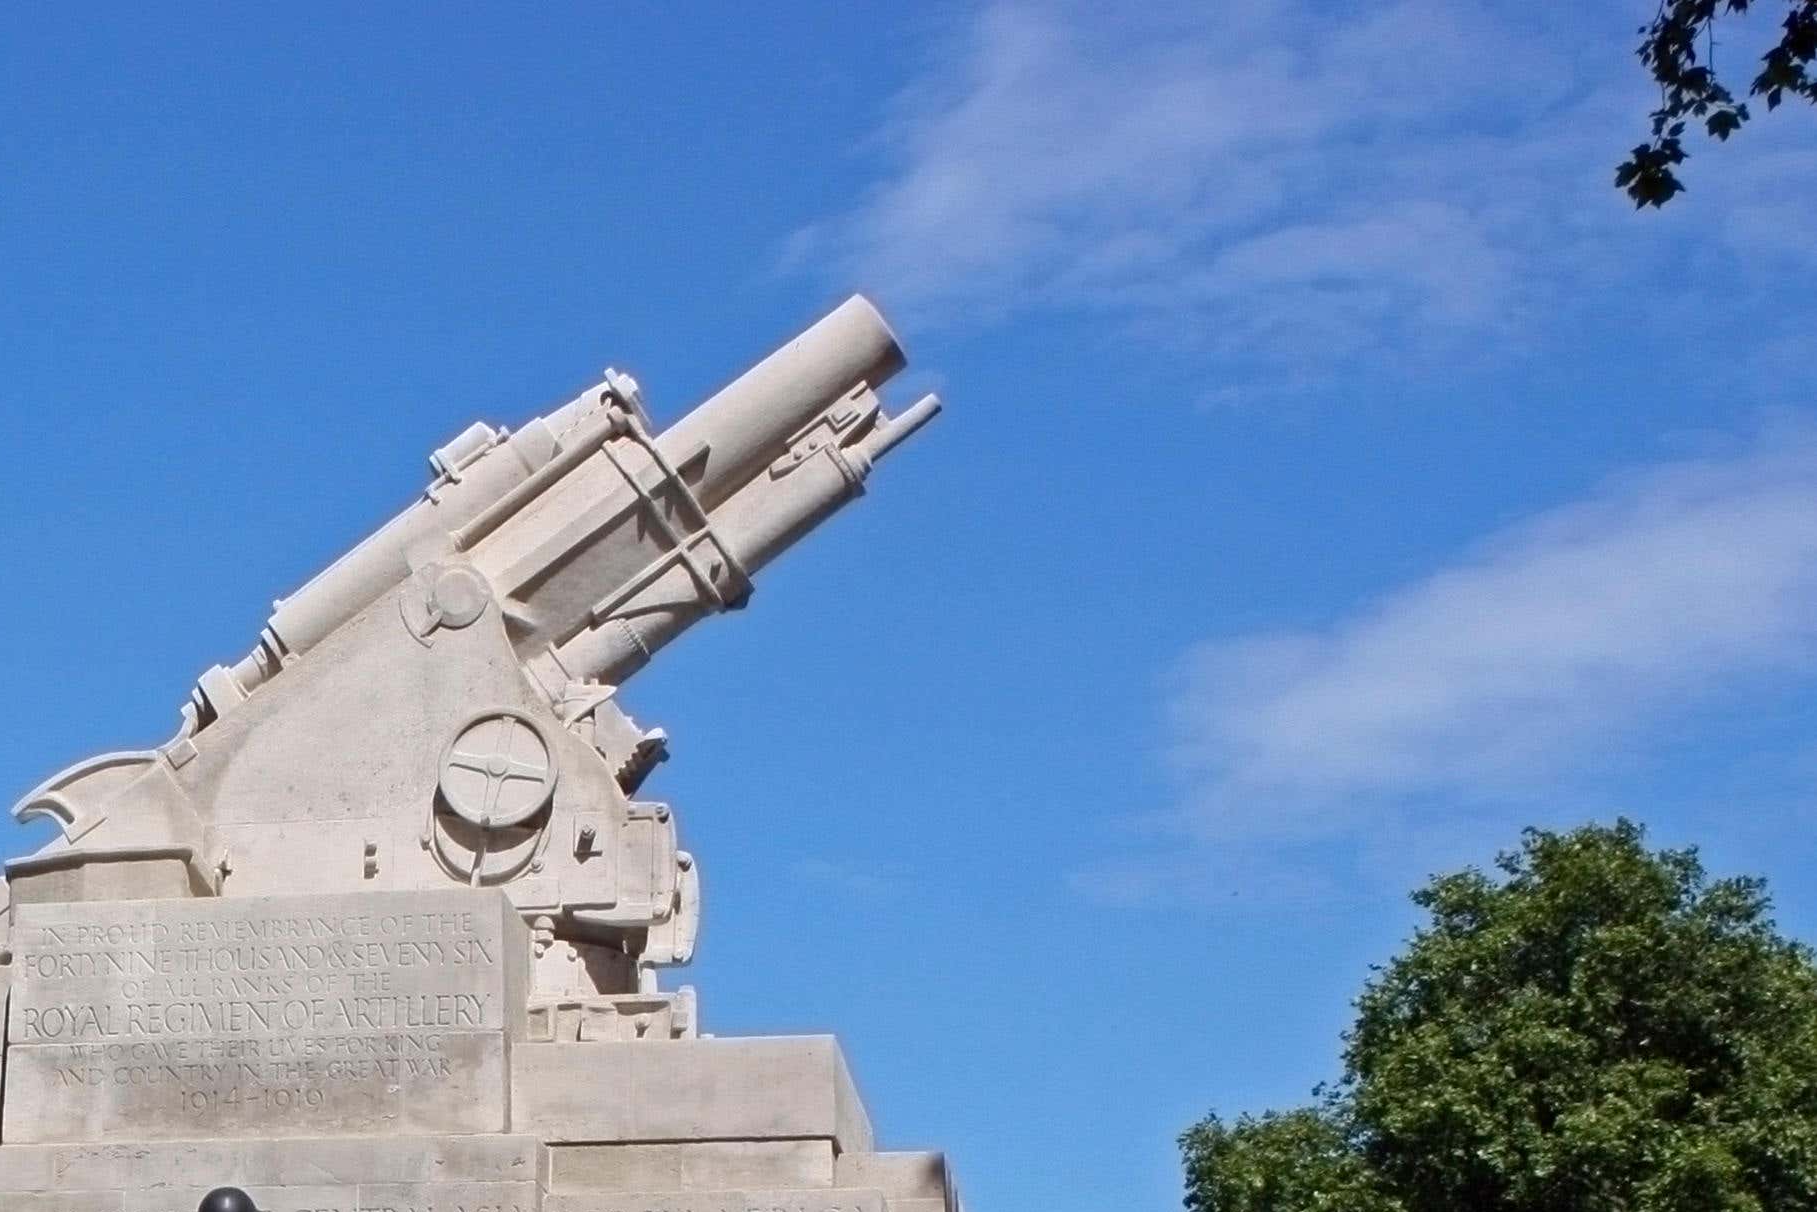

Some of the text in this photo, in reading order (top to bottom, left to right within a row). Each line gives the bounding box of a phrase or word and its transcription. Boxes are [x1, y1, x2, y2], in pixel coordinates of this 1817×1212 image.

[40, 912, 473, 946] IN PROUD REMEMBRANCE OF THE
[180, 944, 324, 973] THOUSAND
[454, 938, 493, 965] SIX
[122, 972, 391, 999] OF ALL RANKS OF THE
[23, 1005, 119, 1039] ROYAL
[283, 998, 325, 1031] OF
[332, 993, 492, 1028] ARTILLERY
[70, 1033, 442, 1062] WHO GAVE THEIR LIVES FOR KING
[53, 1056, 454, 1088] AND COUNTRY IN THE GREAT WAR
